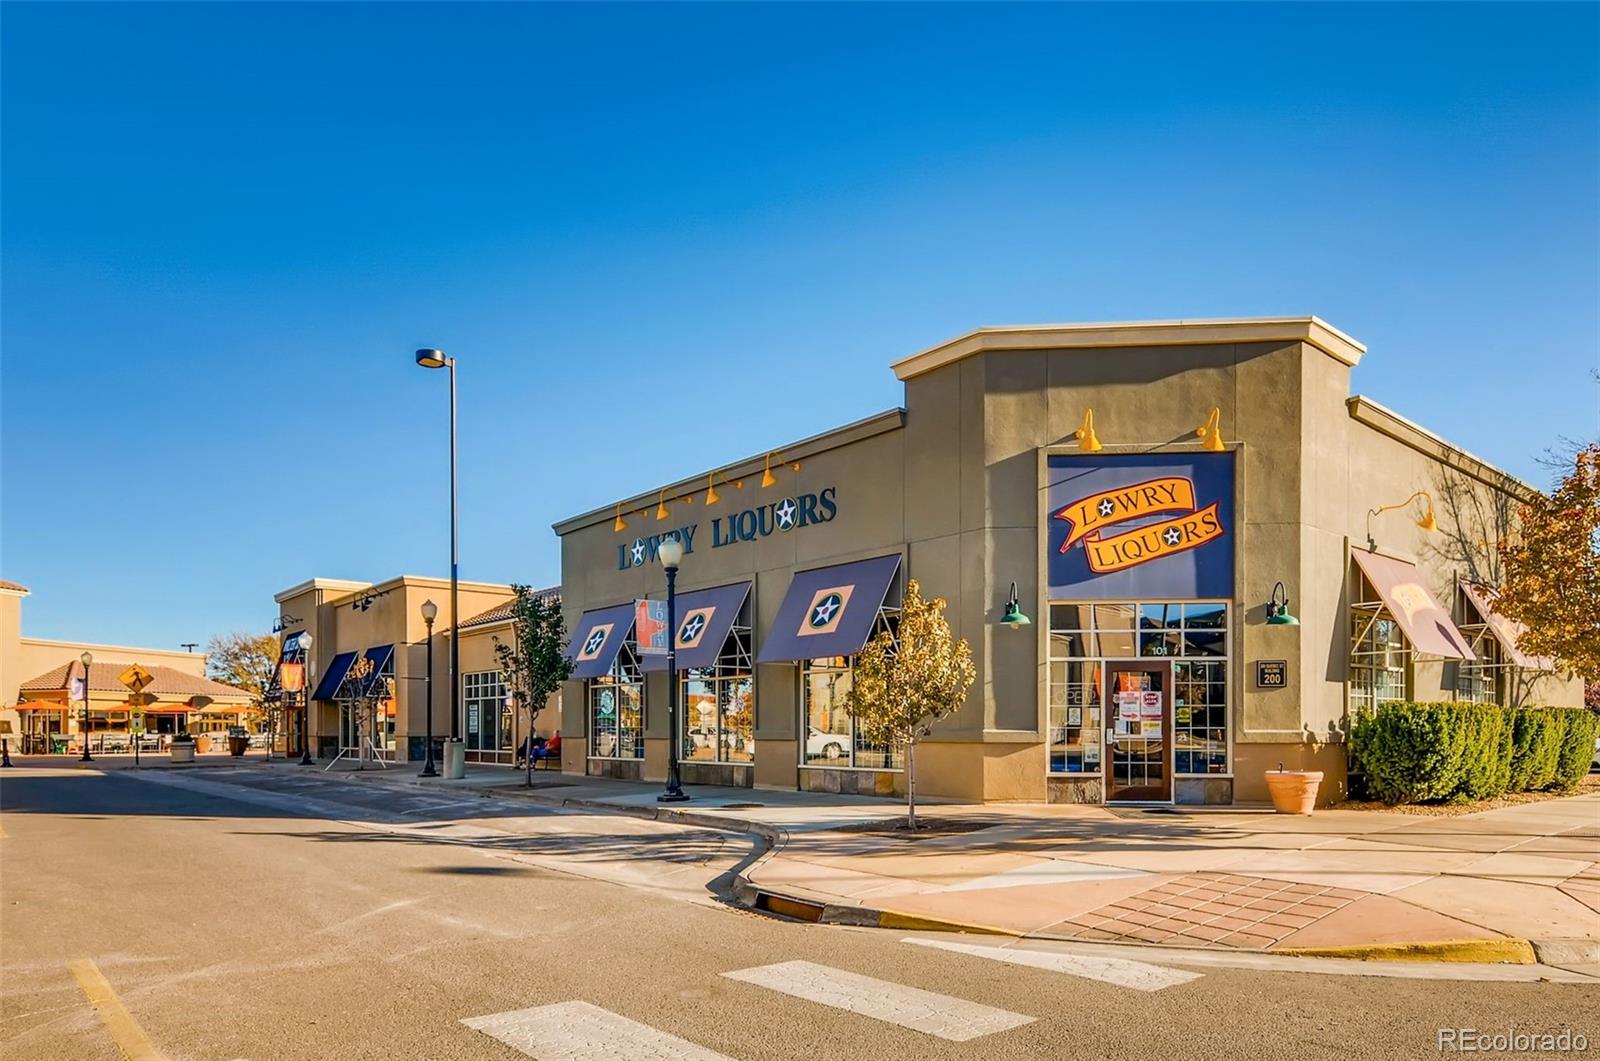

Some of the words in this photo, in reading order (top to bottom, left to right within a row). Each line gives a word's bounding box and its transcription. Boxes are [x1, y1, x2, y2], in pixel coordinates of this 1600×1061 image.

[711, 486, 838, 548] LIQUORS
[1080, 483, 1177, 527] LOWRY
[1094, 511, 1218, 567] LIQUORS
[1151, 647, 1168, 656] 101
[1263, 674, 1281, 684] 200
